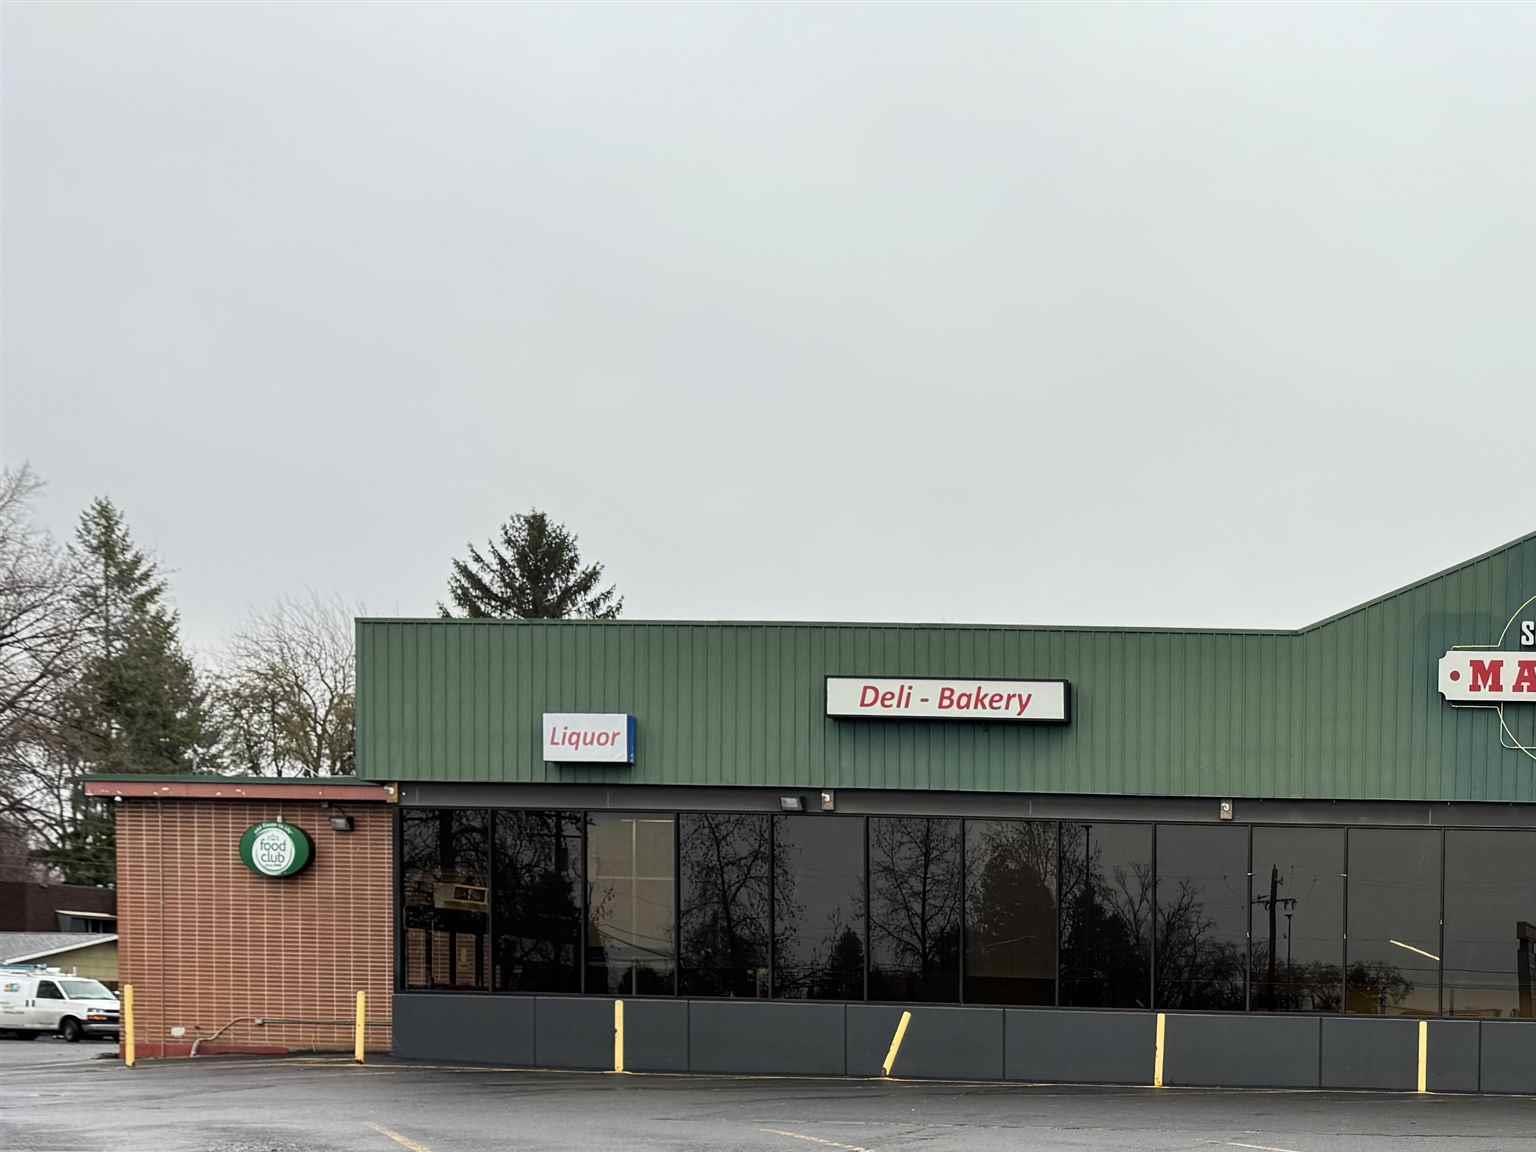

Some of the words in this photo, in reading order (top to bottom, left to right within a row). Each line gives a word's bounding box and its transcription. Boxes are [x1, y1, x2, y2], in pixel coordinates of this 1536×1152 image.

[859, 685, 913, 709] Deli
[938, 686, 1032, 716] Bakery
[550, 726, 621, 751] Liquor
[260, 838, 287, 852] food
[261, 851, 285, 863] club
